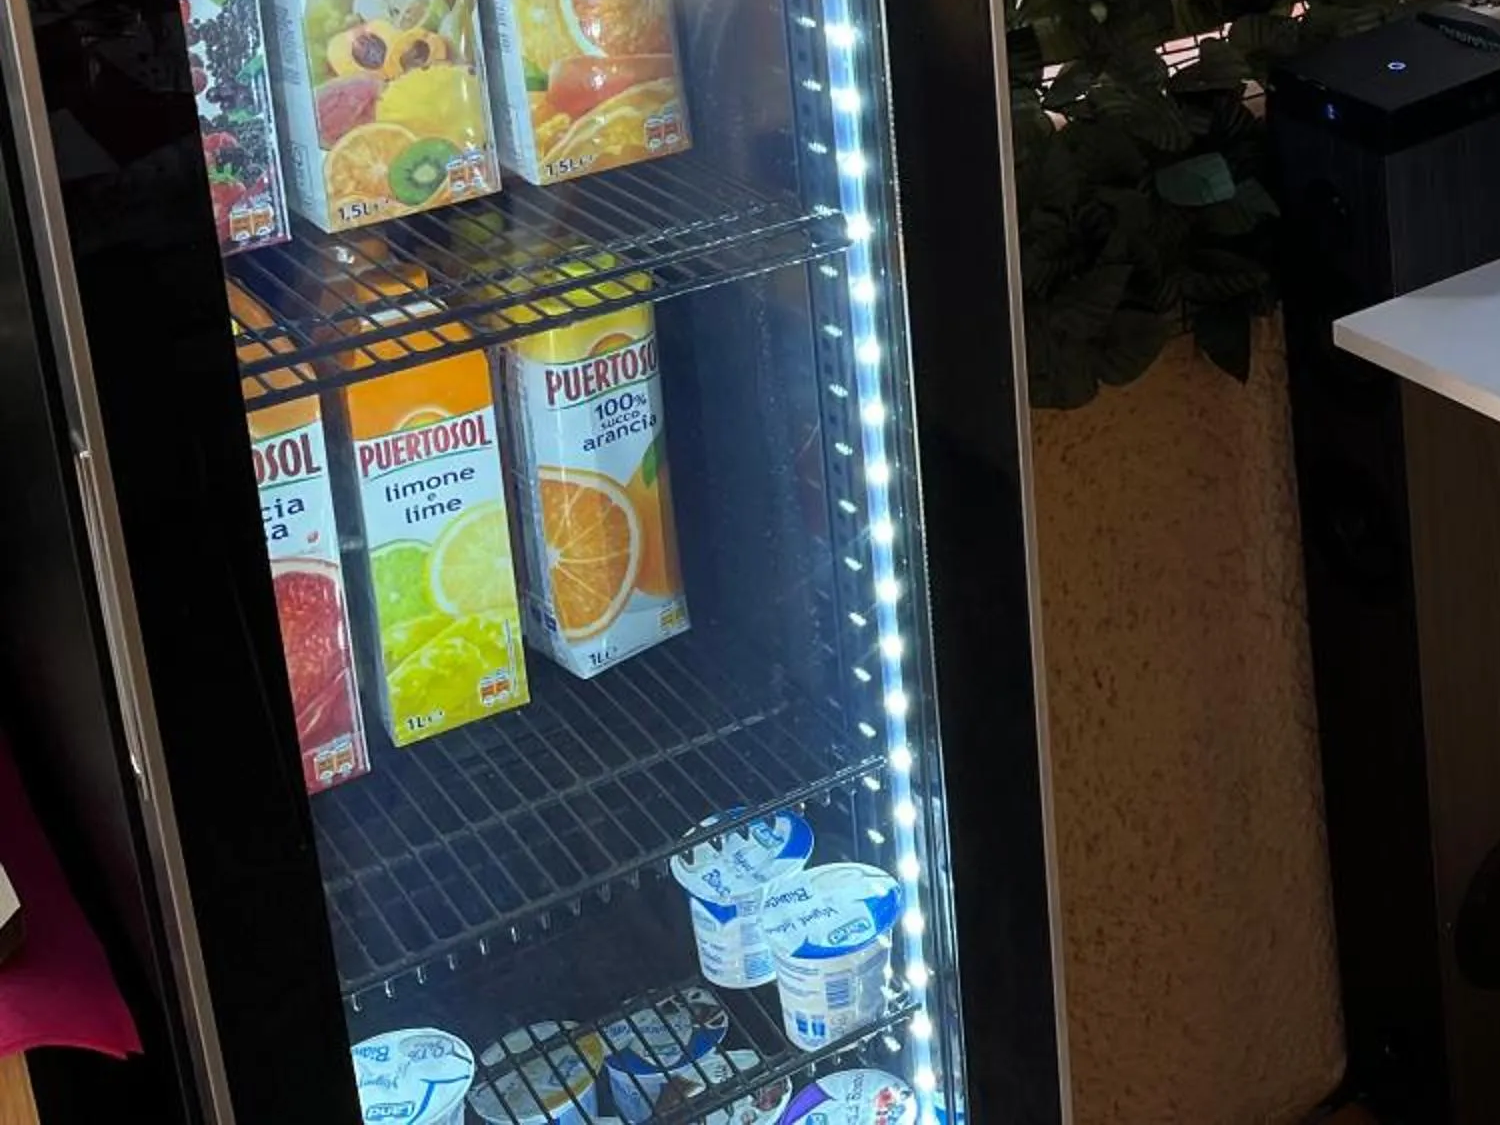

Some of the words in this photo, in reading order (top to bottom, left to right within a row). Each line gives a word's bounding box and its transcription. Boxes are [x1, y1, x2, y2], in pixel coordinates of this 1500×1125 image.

[595, 393, 648, 420] 100%
[601, 410, 640, 429] succo
[359, 415, 493, 478] PUERTOSOL
[583, 414, 657, 452] arancia
[385, 466, 475, 503] limone
[427, 492, 437, 502] e
[405, 497, 462, 524] lime
